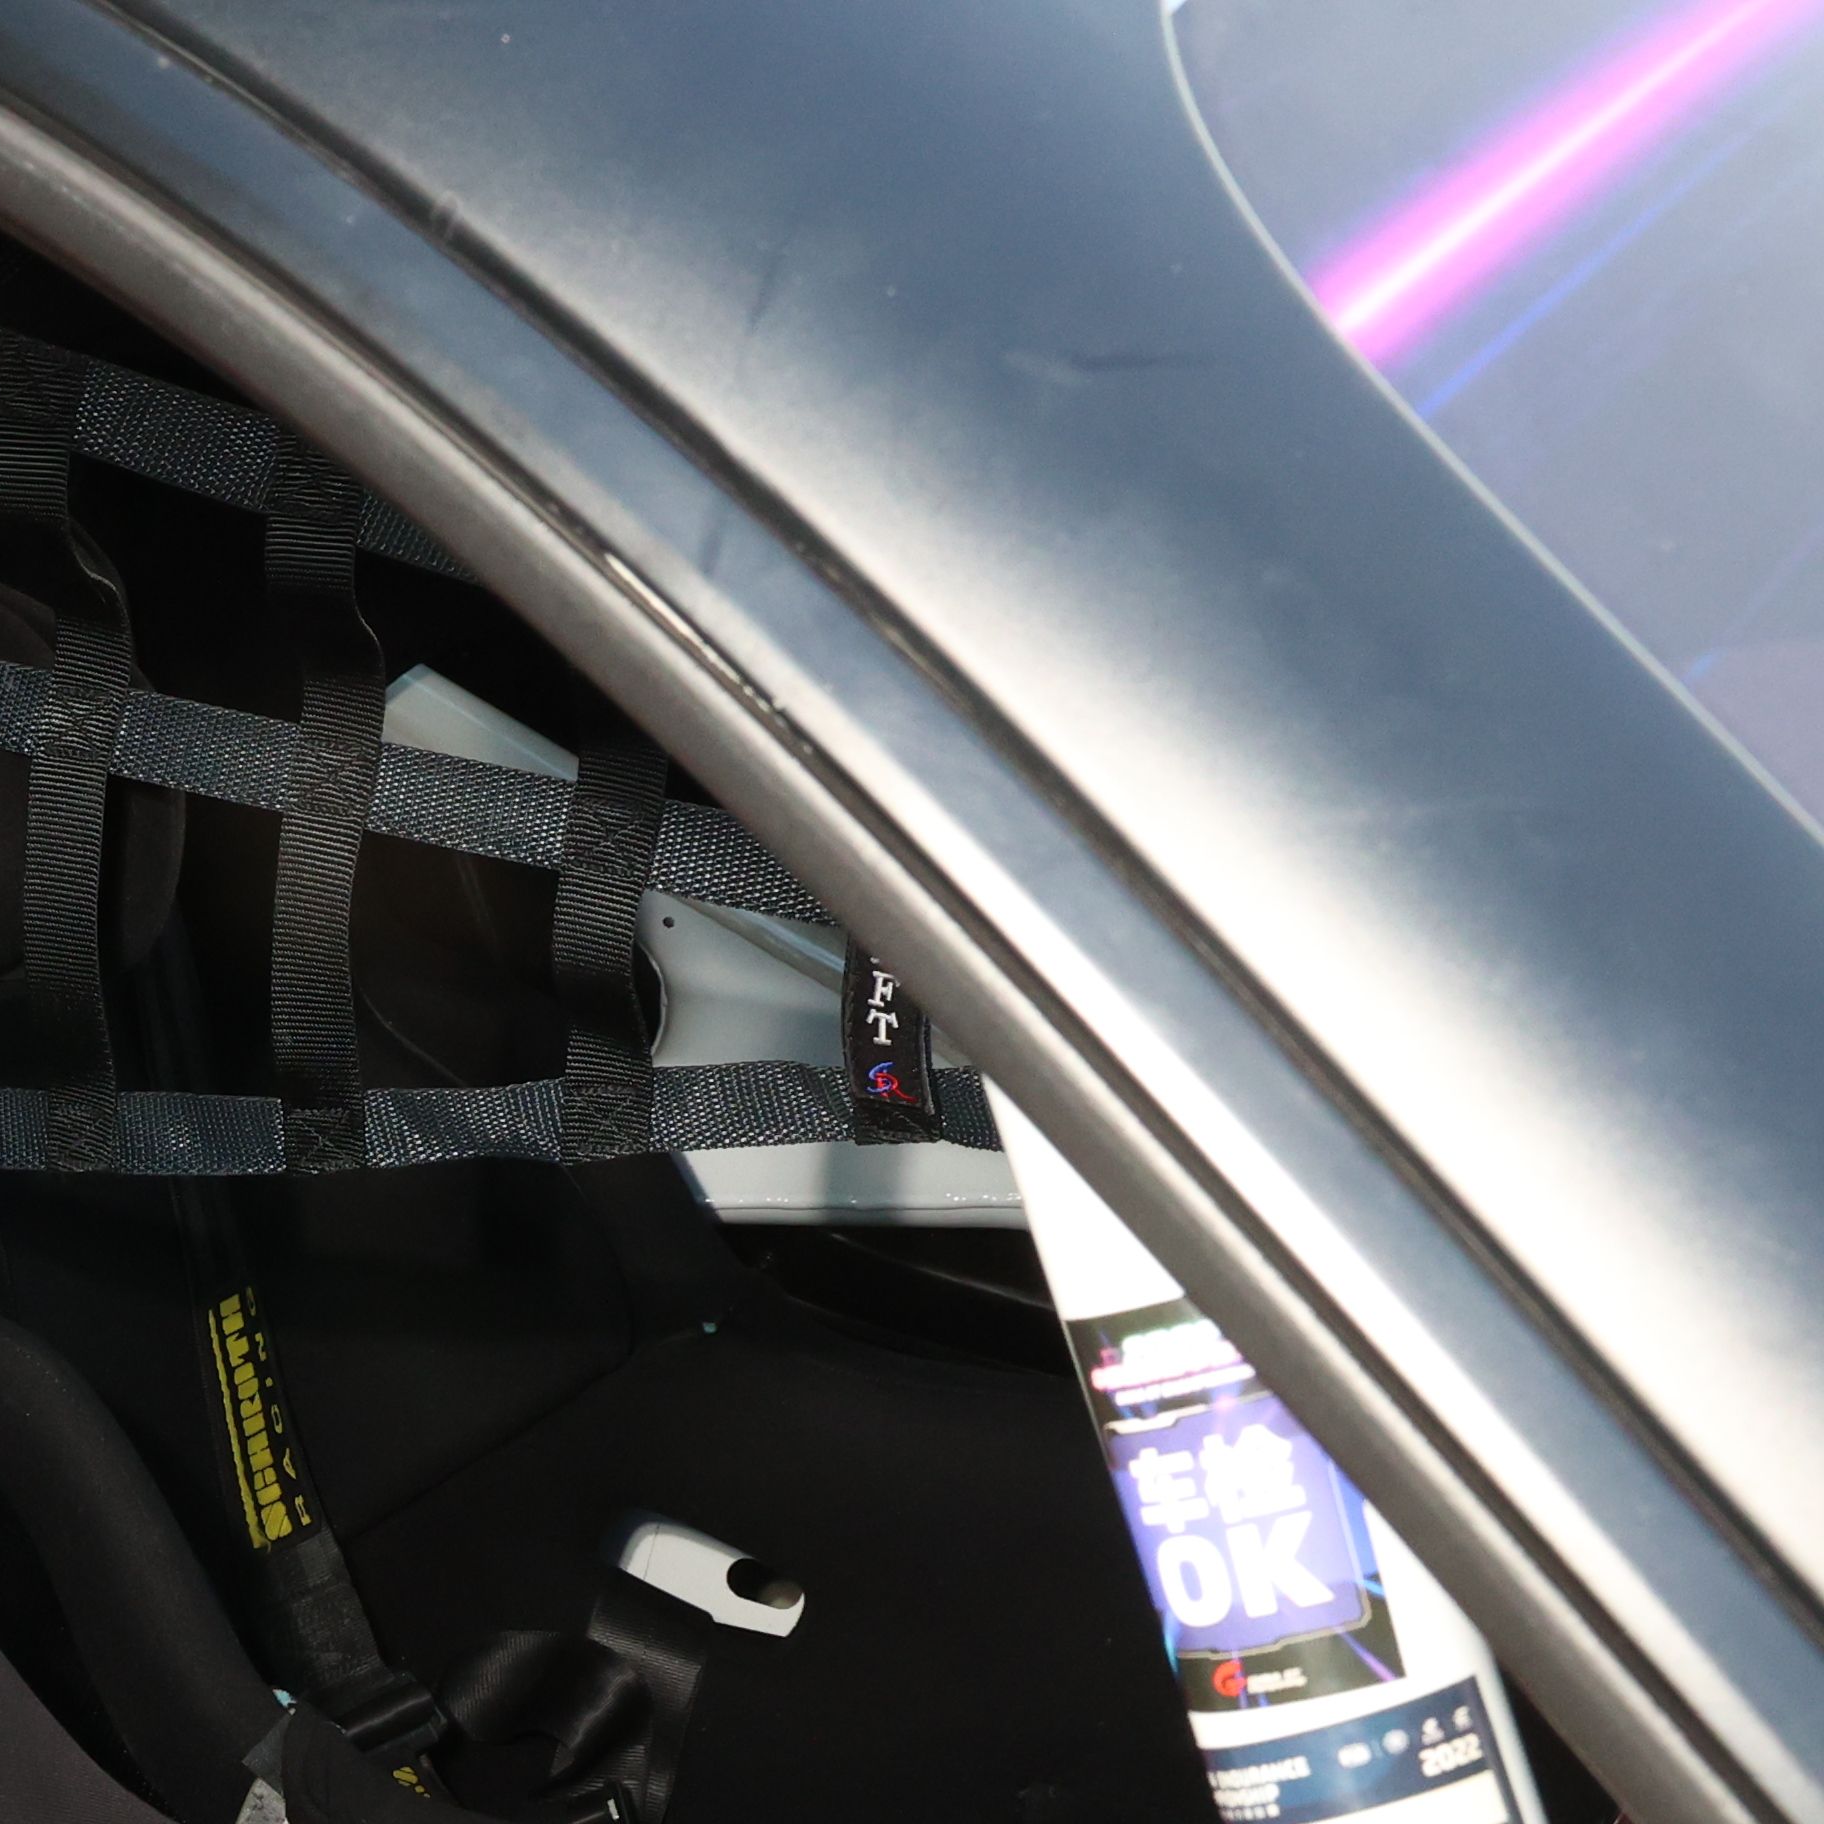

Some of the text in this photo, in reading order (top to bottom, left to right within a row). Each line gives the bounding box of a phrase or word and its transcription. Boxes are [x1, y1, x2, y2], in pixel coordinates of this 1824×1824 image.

[219, 1294, 294, 1541] SCHROTH
[1128, 1423, 1307, 1534] 车检
[1156, 1510, 1335, 1628] OK
[1418, 1732, 1484, 1779] 2022
